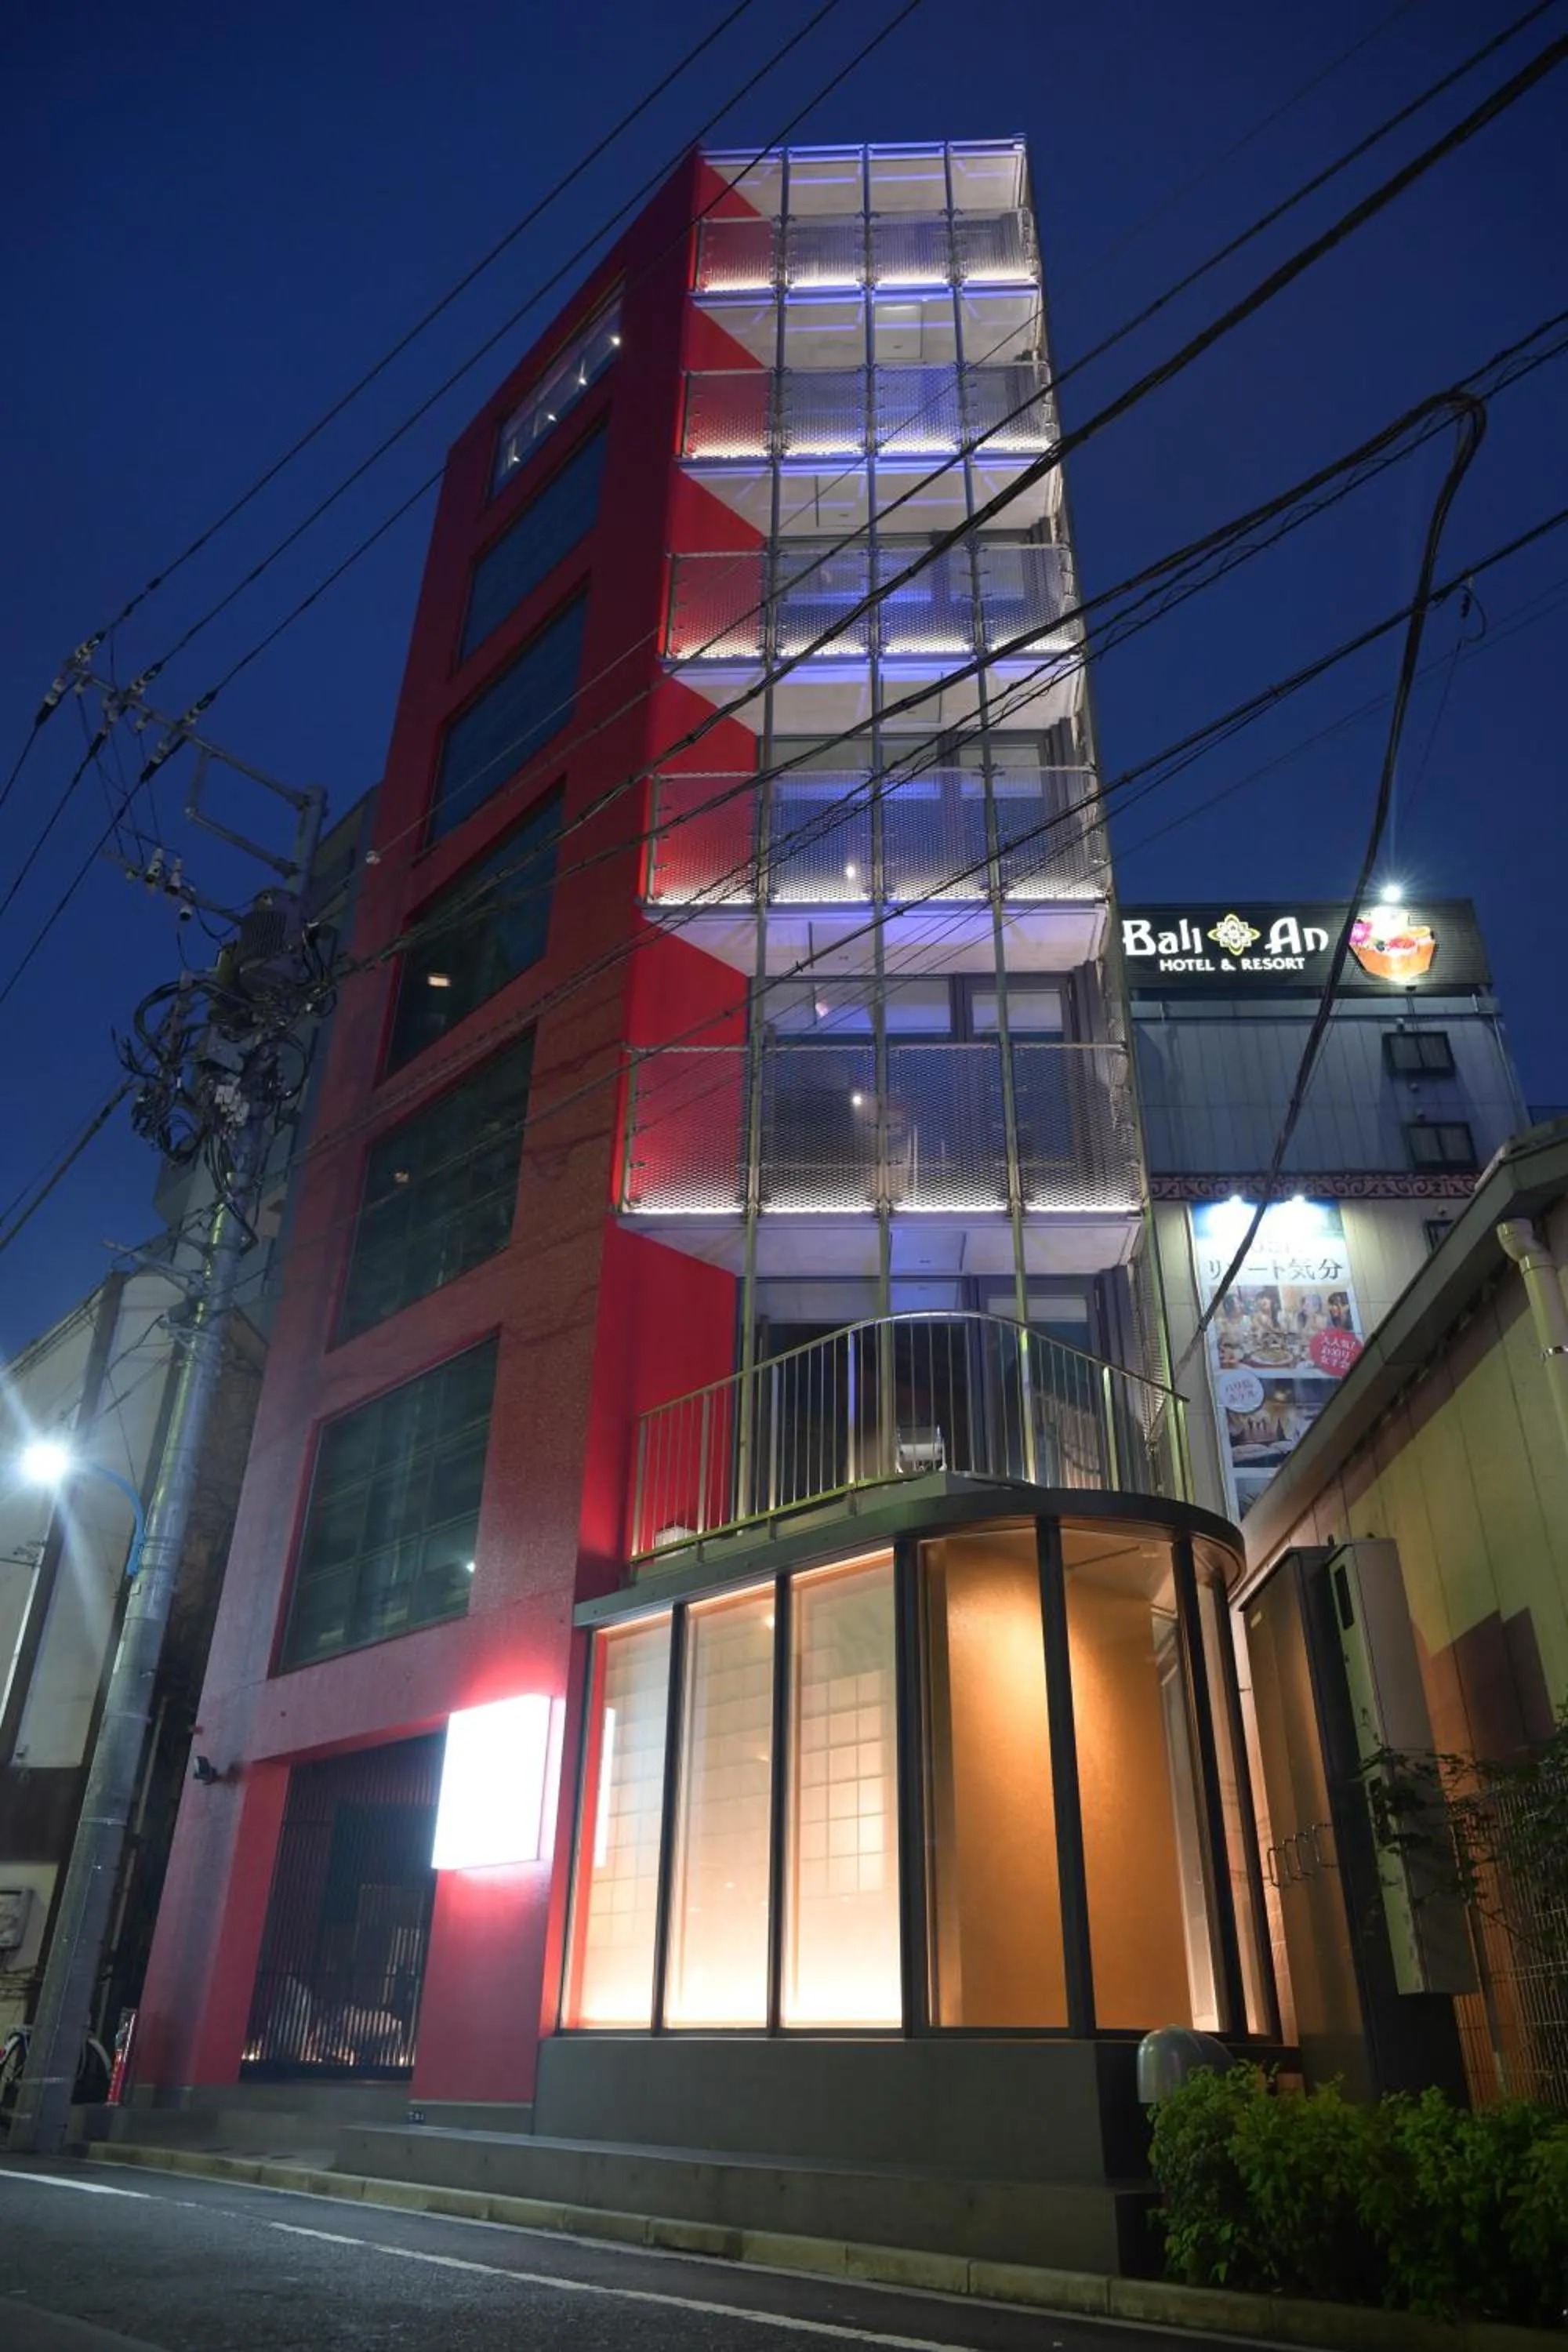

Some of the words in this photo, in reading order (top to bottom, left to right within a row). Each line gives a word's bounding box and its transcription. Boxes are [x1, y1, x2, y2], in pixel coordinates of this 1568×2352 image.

[1122, 918, 1203, 956] Bali
[1264, 916, 1330, 954] An
[1159, 957, 1216, 972] HOTEL
[1220, 957, 1236, 971] &
[1241, 956, 1306, 971] RESORT
[1208, 1258, 1343, 1281] リート気分
